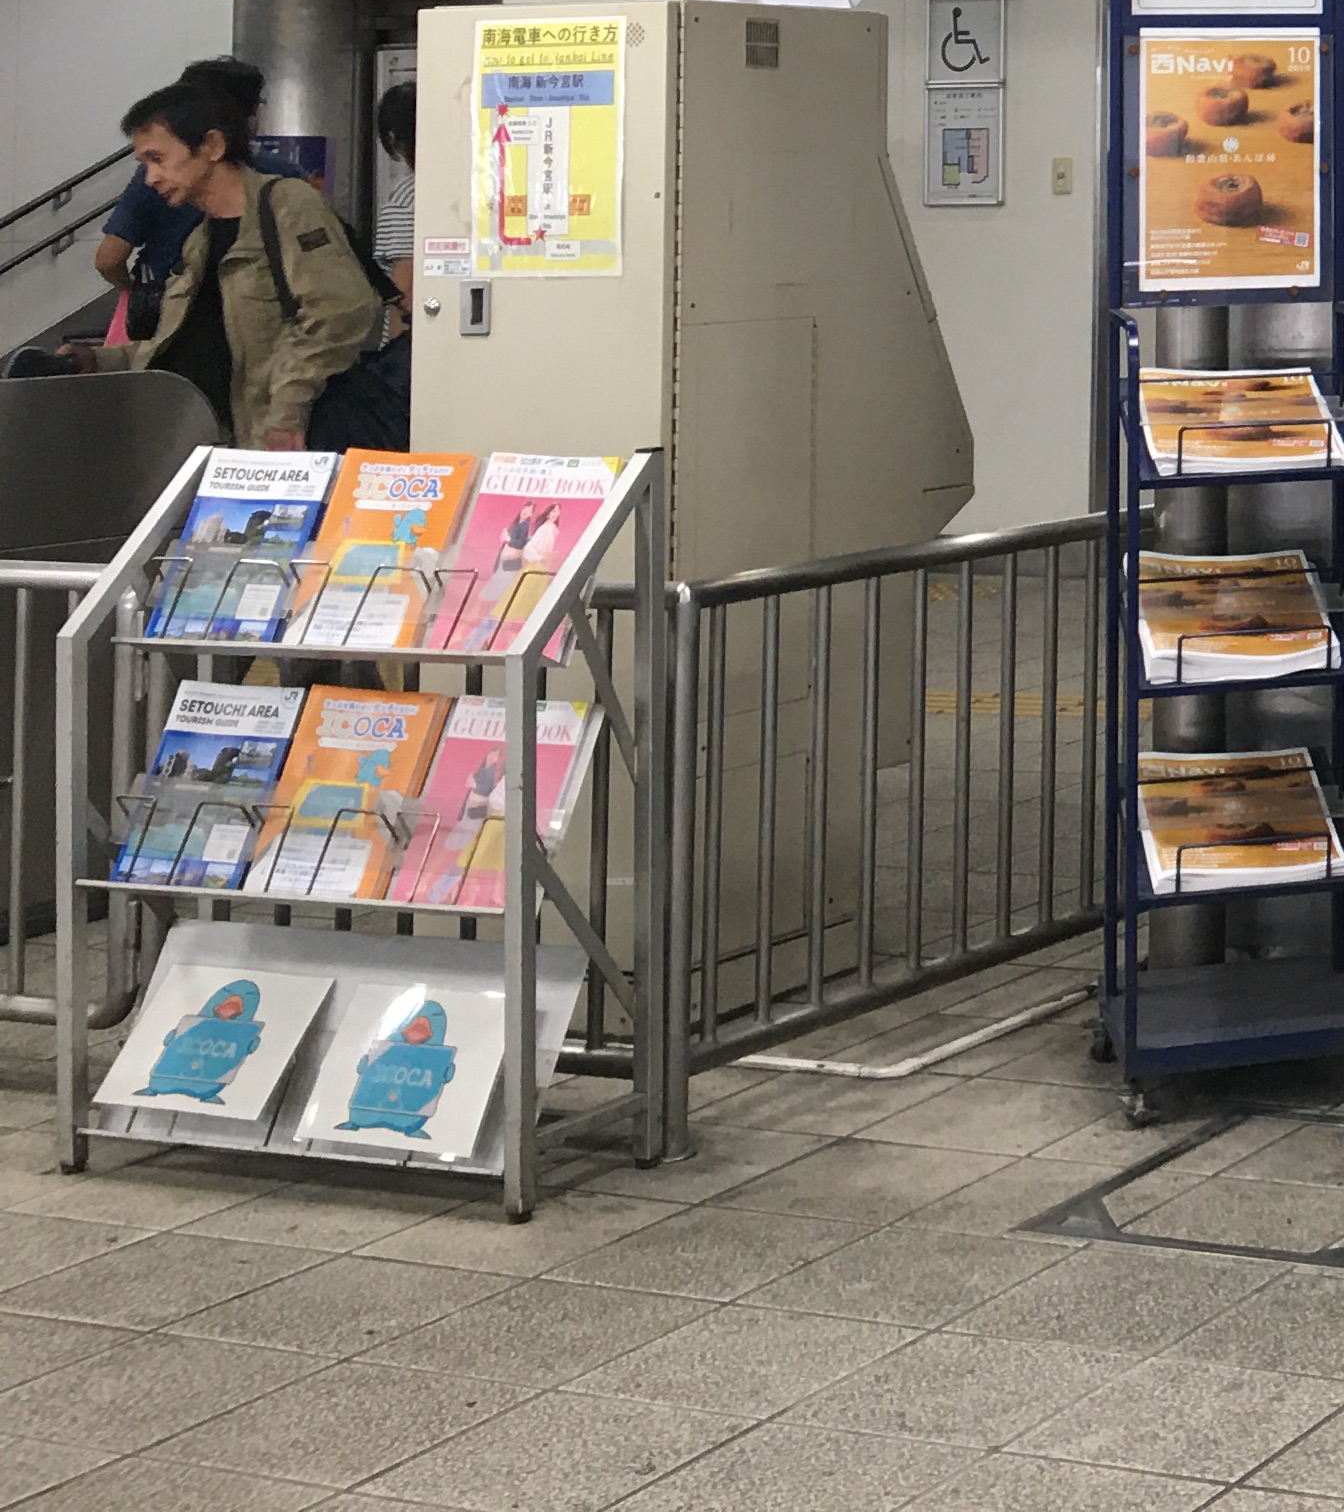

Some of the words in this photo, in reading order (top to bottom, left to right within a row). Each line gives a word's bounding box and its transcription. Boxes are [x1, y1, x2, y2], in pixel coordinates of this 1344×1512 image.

[482, 25, 618, 45] 南海電車への行き方
[507, 54, 516, 65] to
[520, 54, 535, 66] get
[540, 53, 549, 64] to
[591, 51, 614, 63] Line
[1287, 46, 1310, 64] 10
[1151, 54, 1234, 74] 西Navi
[508, 75, 532, 89] 南海
[536, 74, 584, 88] 新今宮駅
[543, 117, 553, 195] JR新今宮駅
[1296, 260, 1309, 270] JR
[315, 456, 329, 465] JR
[213, 467, 276, 482] SETOUCHI
[278, 469, 310, 482] AREA
[209, 481, 245, 492] TOURISM
[247, 484, 270, 492] GUIDE
[353, 474, 444, 500] ICOCA
[486, 474, 553, 494] GUIDE
[555, 478, 605, 496] BOOK
[1275, 558, 1297, 568] 10
[284, 691, 298, 701] JR
[179, 699, 247, 717] SETOUCHI
[248, 705, 279, 718] AREA
[176, 714, 213, 725] TOURISM
[215, 718, 239, 727] GUIDE
[316, 710, 409, 740] ICOCA
[1279, 756, 1301, 767] 10
[177, 1037, 236, 1059] ICOCA
[374, 1065, 433, 1086] ICOCA
